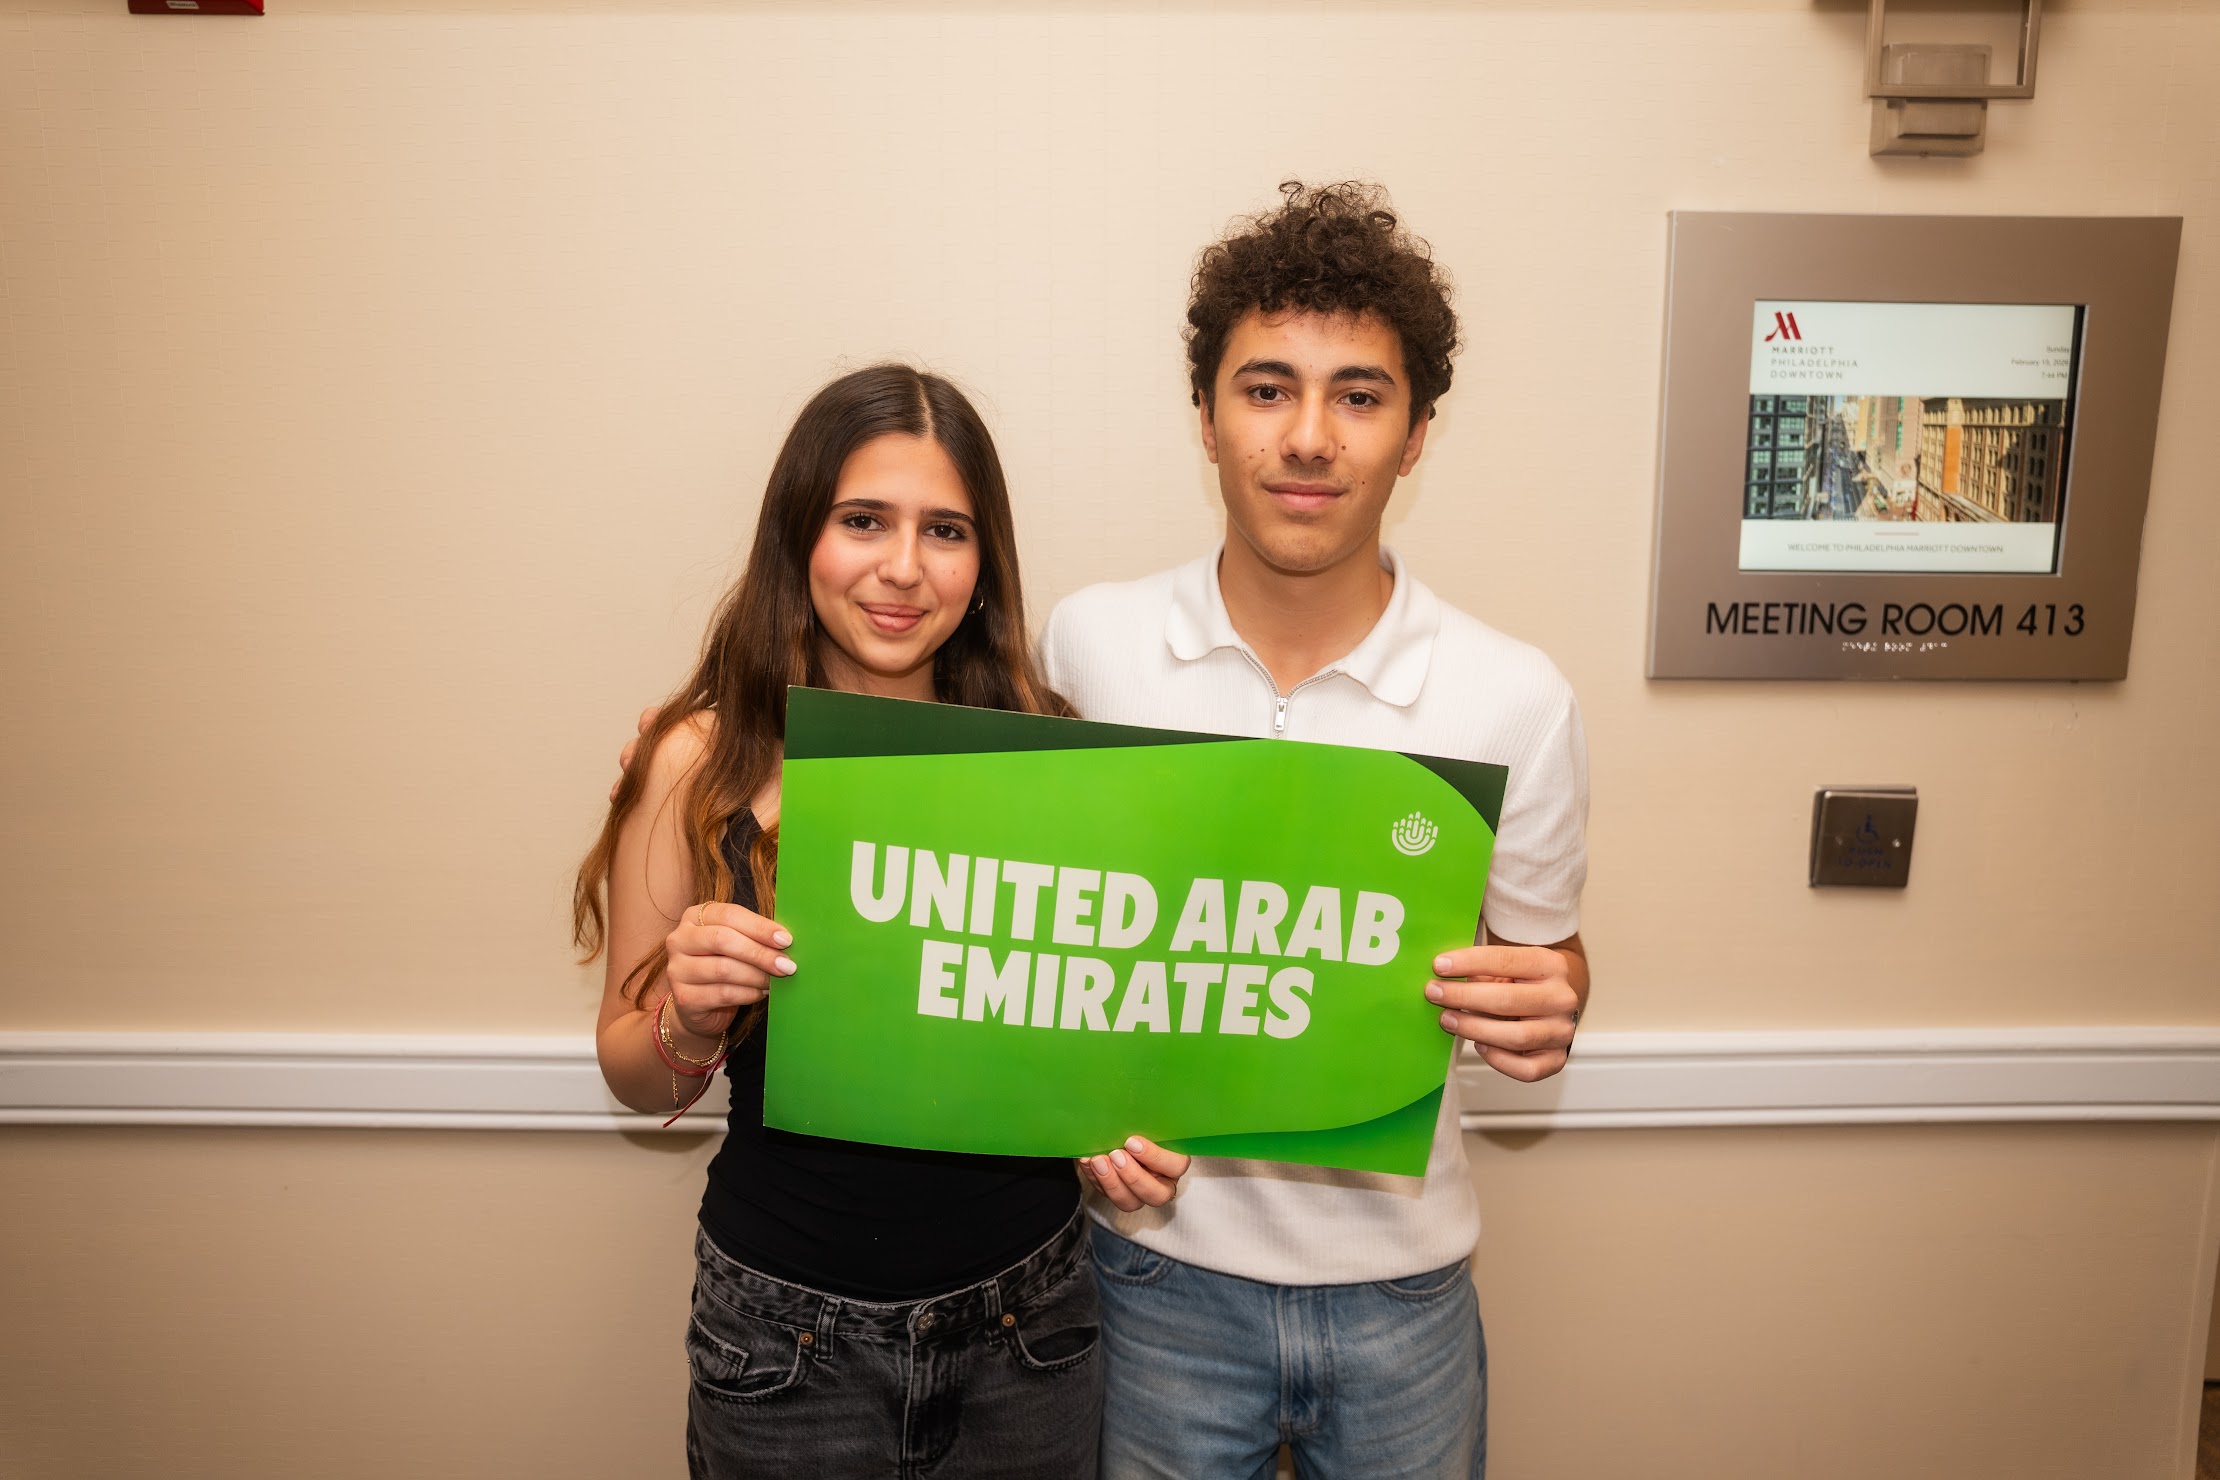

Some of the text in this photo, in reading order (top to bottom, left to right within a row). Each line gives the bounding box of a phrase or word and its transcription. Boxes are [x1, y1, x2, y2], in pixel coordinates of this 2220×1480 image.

[1771, 346, 1834, 355] MARRIOTT
[1770, 359, 1858, 368] PHILADELPHIA
[1770, 370, 1843, 379] DOWNTOWN
[1787, 543, 2004, 553] WELCOME TO PHILADELPHIA MARRIOTT DOWNTOWN
[1705, 602, 2086, 637] MEETING ROOM 413
[850, 840, 1406, 967] UNITED ARAB
[916, 939, 1315, 1040] EMIRATES
